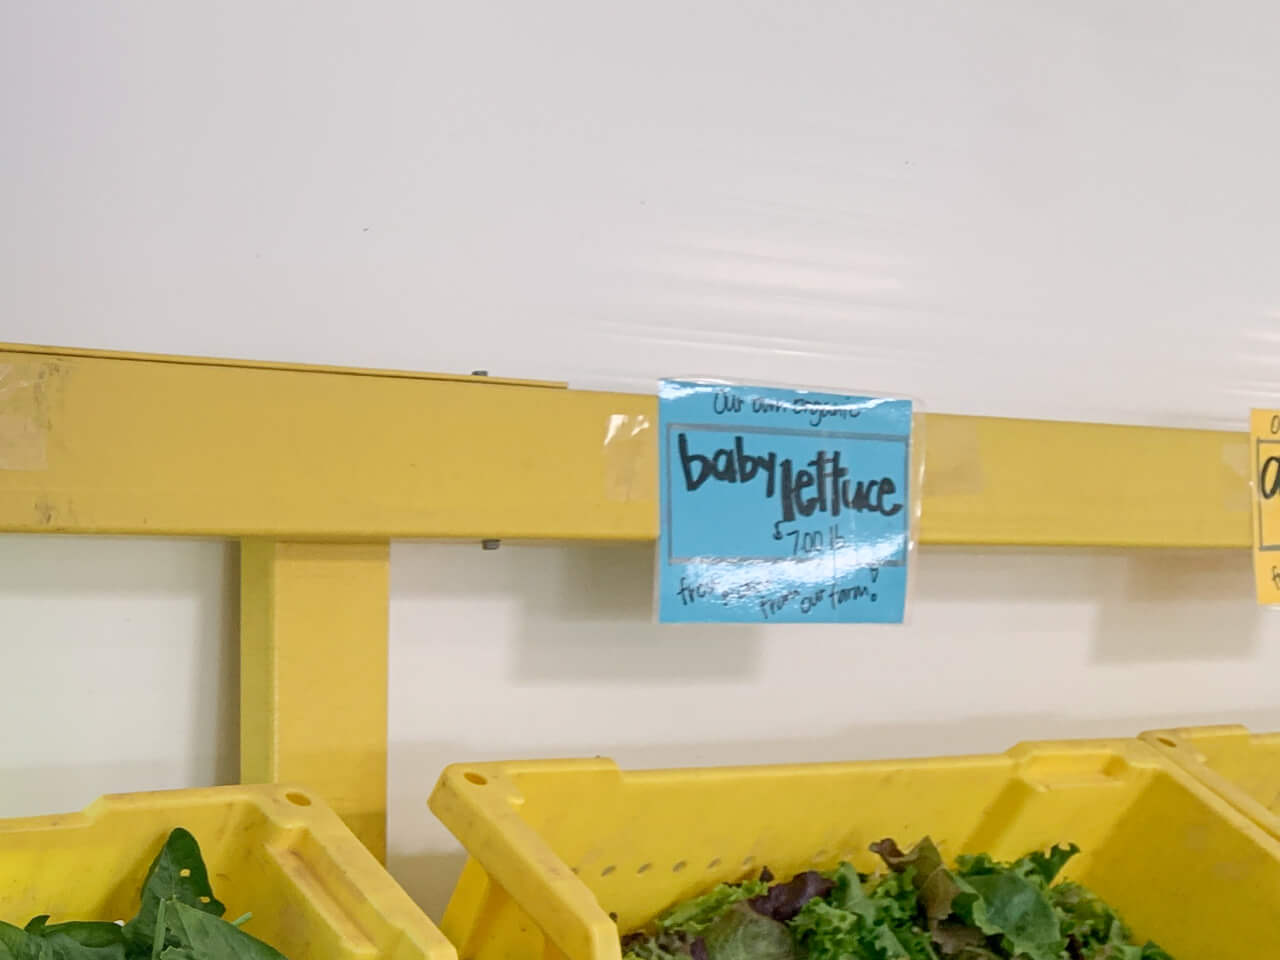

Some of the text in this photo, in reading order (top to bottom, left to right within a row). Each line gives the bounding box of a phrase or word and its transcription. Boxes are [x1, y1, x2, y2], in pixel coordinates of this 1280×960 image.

[678, 433, 904, 521] baby lettuce
[829, 567, 880, 610] farm!
